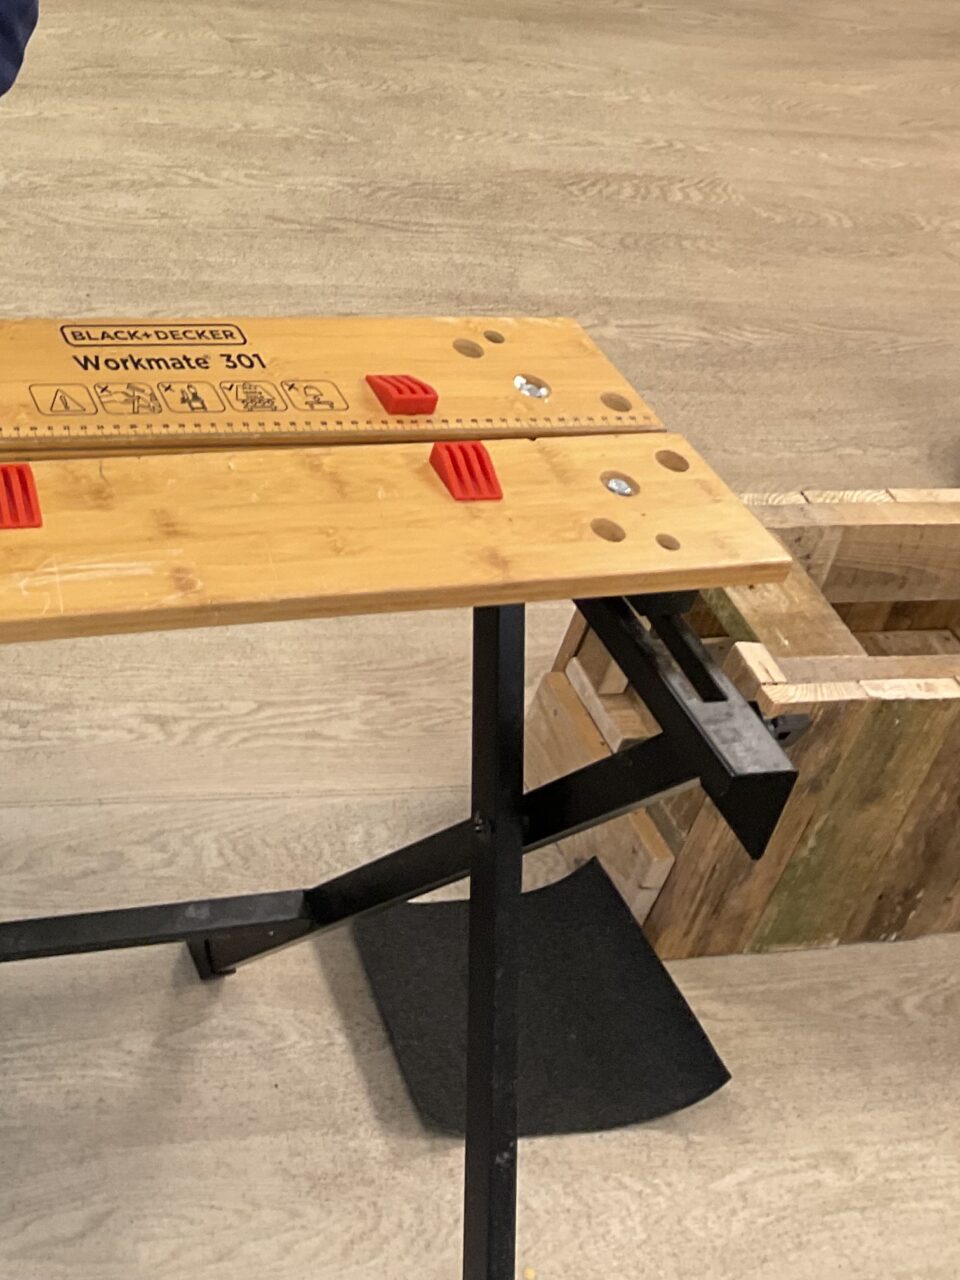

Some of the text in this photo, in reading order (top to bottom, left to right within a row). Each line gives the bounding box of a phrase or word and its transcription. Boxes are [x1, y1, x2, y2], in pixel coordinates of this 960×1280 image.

[70, 329, 238, 341] BLACK+DECKER
[72, 353, 267, 371] Workmate 301
